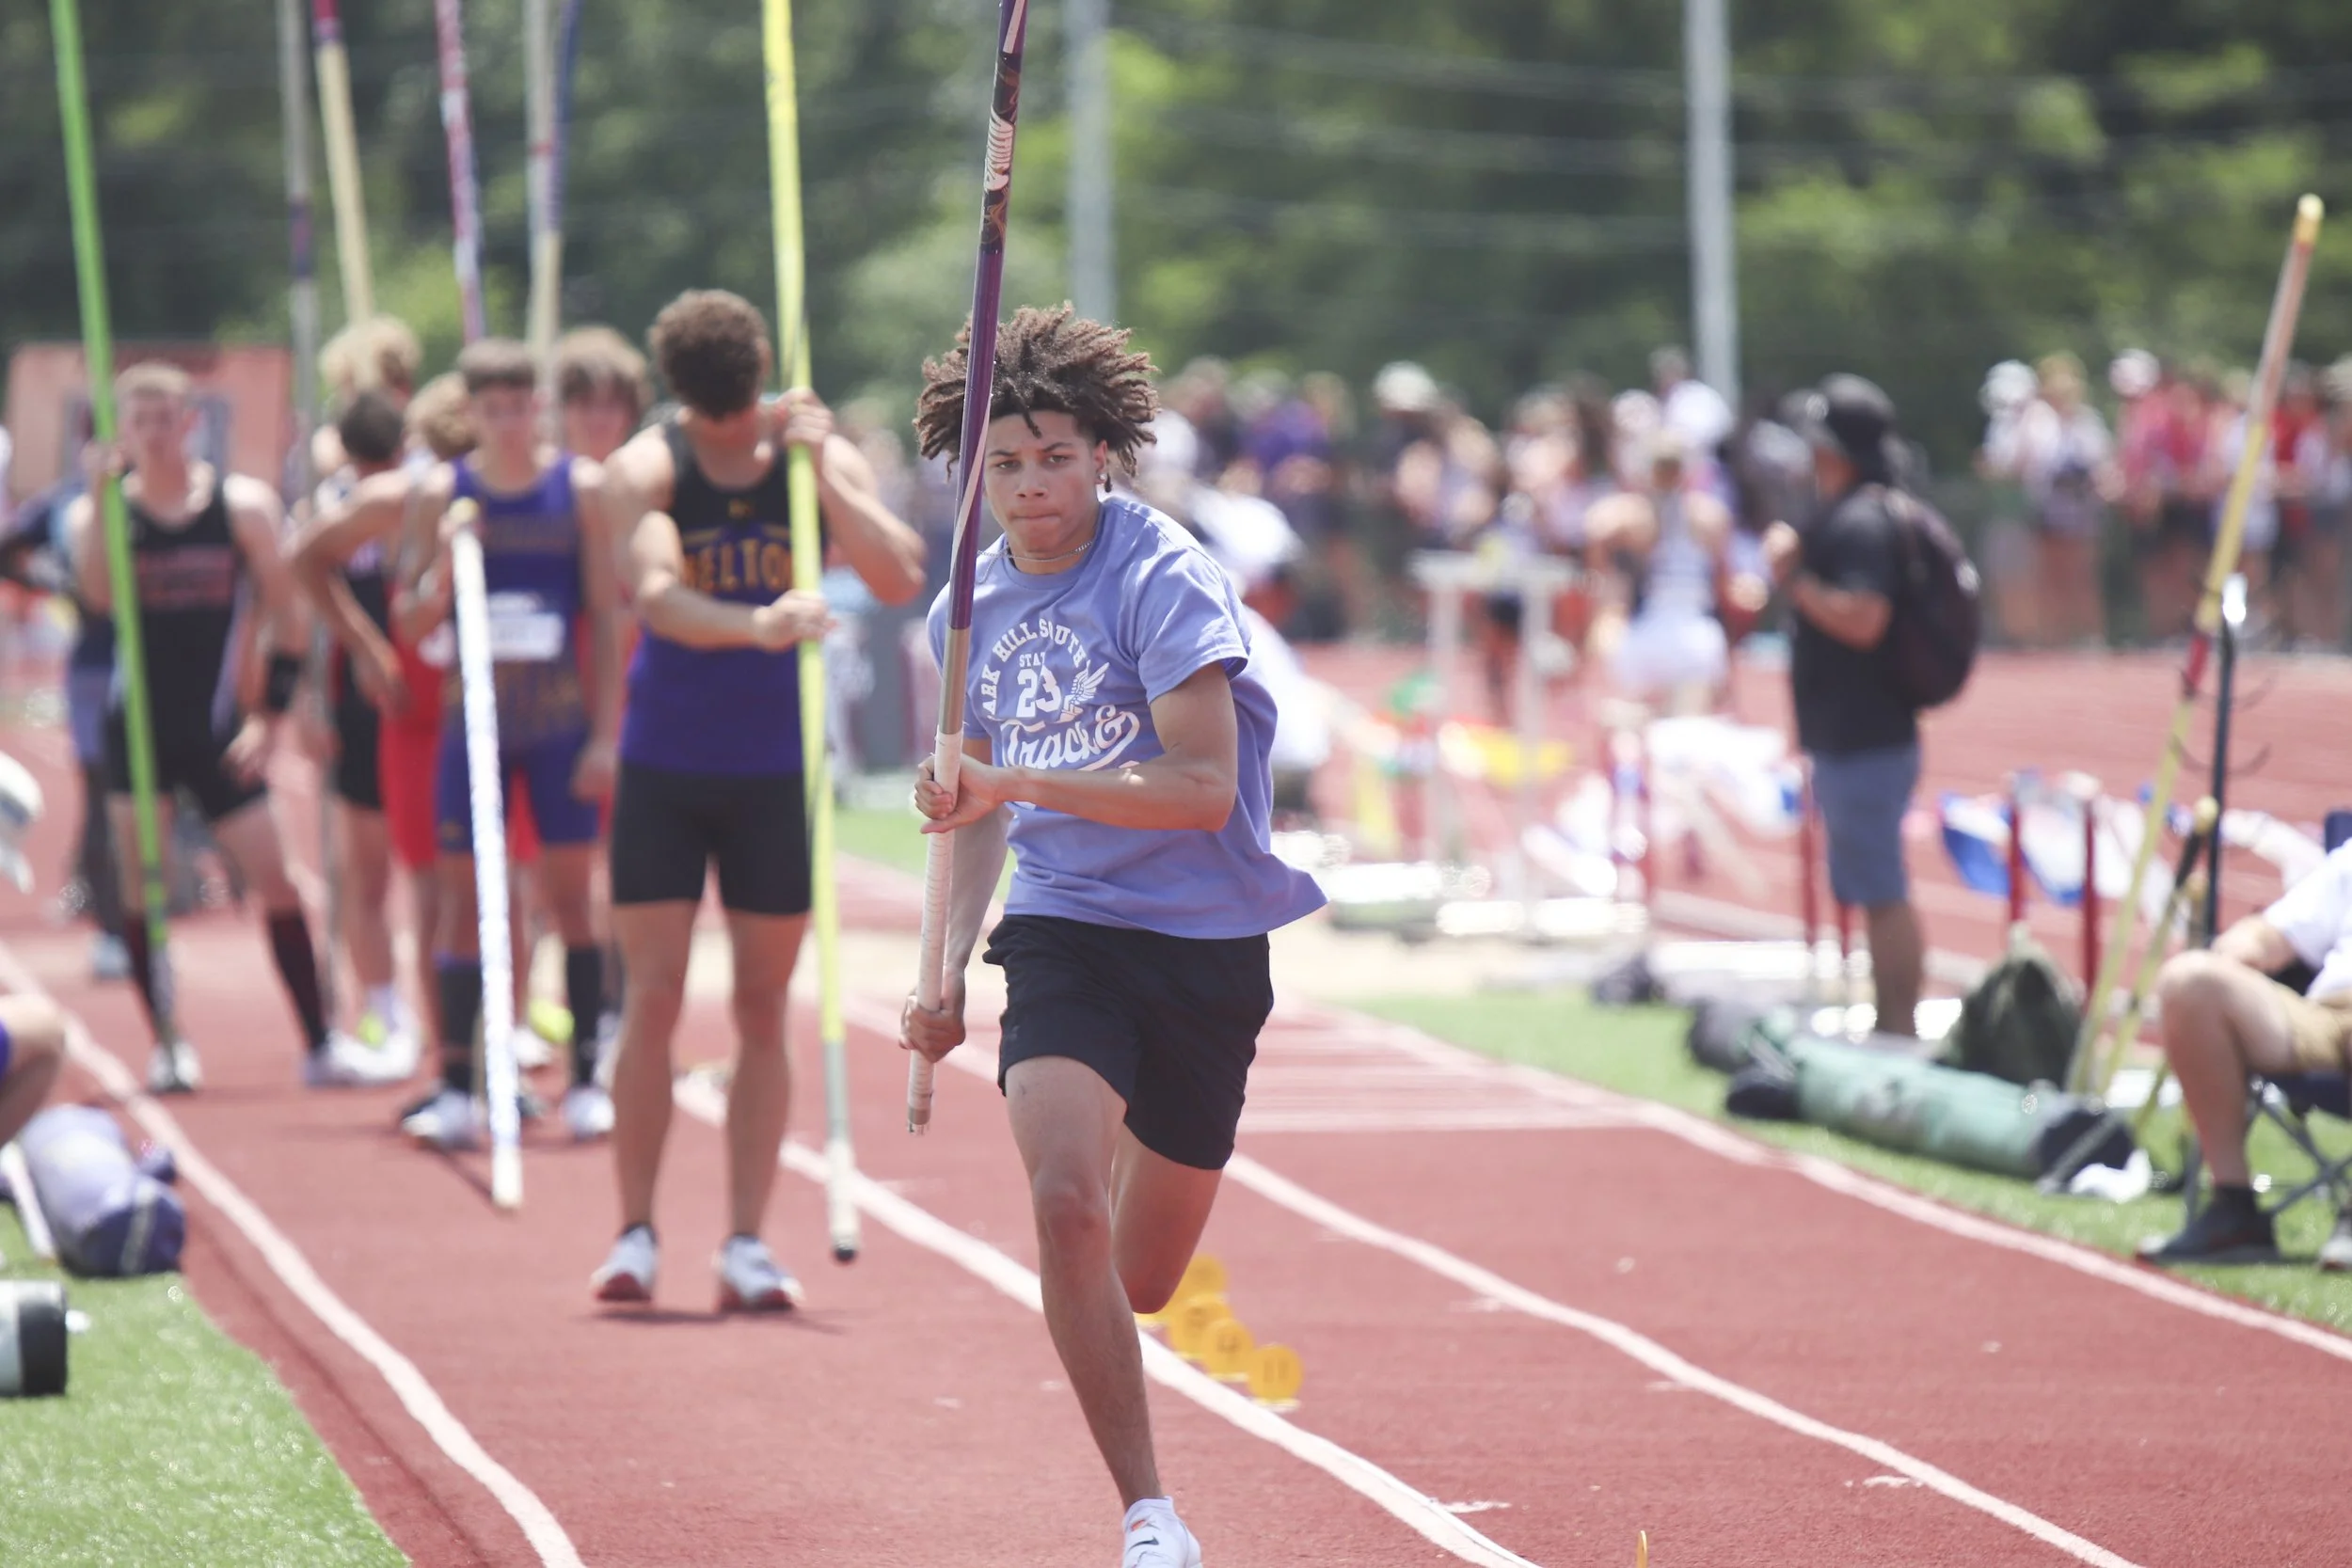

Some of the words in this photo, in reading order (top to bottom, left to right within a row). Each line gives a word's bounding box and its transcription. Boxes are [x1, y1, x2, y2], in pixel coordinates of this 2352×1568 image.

[682, 538, 795, 595] ELTO
[981, 664, 1000, 720] ARK
[993, 622, 1038, 662] HILL
[1016, 669, 1062, 718] 23
[1000, 719, 1101, 769] Track
